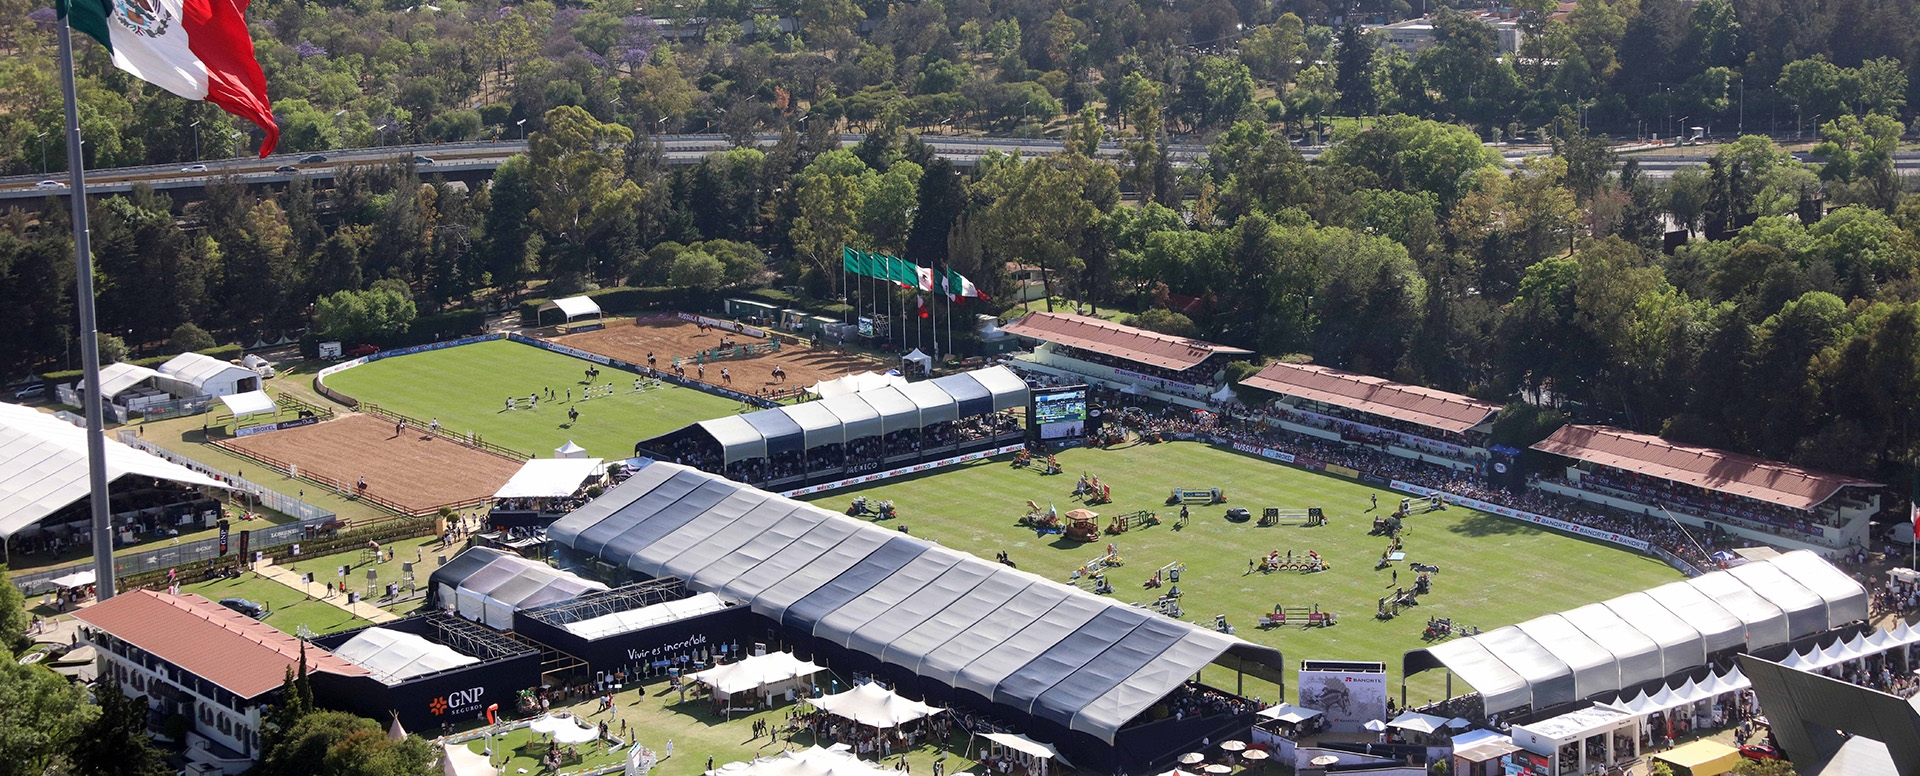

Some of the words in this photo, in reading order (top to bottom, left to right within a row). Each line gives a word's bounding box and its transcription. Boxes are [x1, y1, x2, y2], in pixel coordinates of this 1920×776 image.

[1233, 442, 1262, 455] RUSSULA
[890, 468, 907, 476] MÉXICO
[817, 483, 835, 491] MÉXICO
[1541, 518, 1570, 530] BANORTE
[1579, 528, 1609, 539] BANORTE
[1618, 537, 1648, 549] BANORTE
[628, 648, 650, 659] Vivir
[652, 647, 660, 656] es
[448, 686, 484, 708] GNP
[452, 704, 482, 715] SEGUROS
